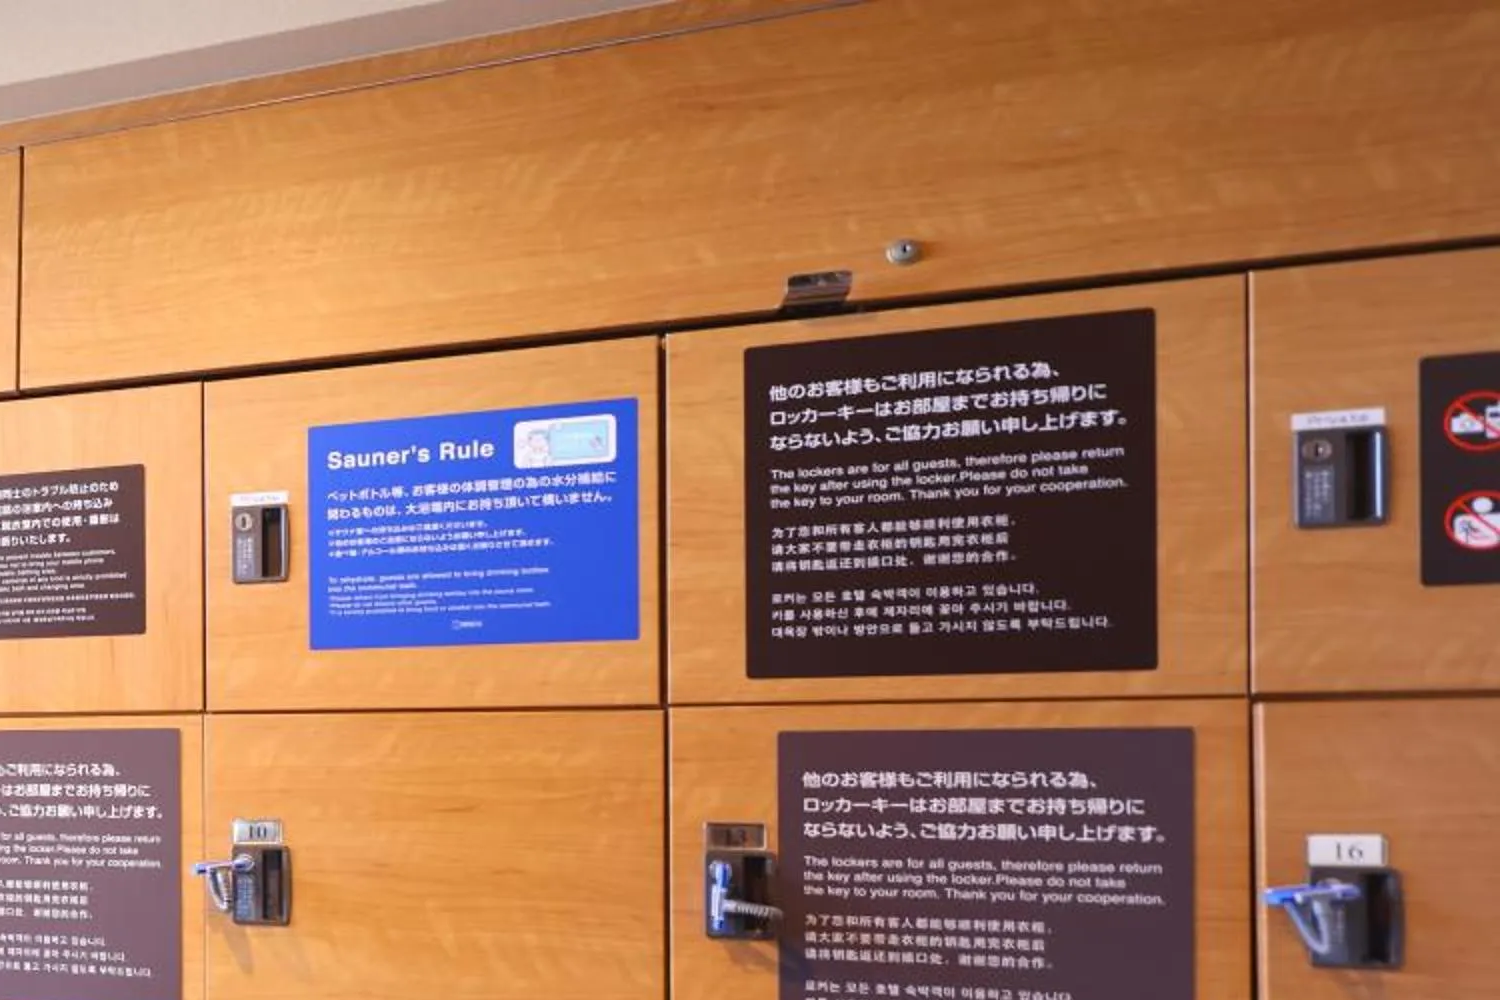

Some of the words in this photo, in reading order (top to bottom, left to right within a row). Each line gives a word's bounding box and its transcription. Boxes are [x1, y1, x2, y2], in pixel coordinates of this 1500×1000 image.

[768, 361, 1059, 402] 他のお客様もご利用になられる為、
[769, 383, 1106, 426] ロッカーキーはお部屋までお持ち帰りに
[769, 408, 1126, 451] ならないよう、ご協力お願い申し上げます。
[327, 444, 430, 470] Sauner's
[439, 439, 495, 460] Rule
[769, 468, 794, 479] The
[797, 466, 844, 478] lockers
[847, 464, 869, 475] are
[871, 462, 890, 473] for
[893, 459, 909, 472] all
[964, 452, 1027, 466] therefore
[1030, 450, 1078, 464] please
[1081, 447, 1125, 459] return
[769, 483, 790, 495] the
[793, 482, 816, 494] key
[819, 479, 849, 491] after
[852, 478, 887, 490] using
[891, 475, 912, 486] the
[1010, 467, 1028, 479] do
[1032, 465, 1053, 476] not
[1058, 463, 1088, 475] take
[769, 498, 791, 509] the
[793, 497, 817, 509] key
[819, 495, 833, 506] to
[835, 494, 864, 507] your
[867, 491, 904, 503] room.
[908, 487, 950, 500] Thank
[954, 487, 979, 500] you
[983, 483, 1001, 496] for
[1005, 483, 1036, 497] your
[1039, 477, 1127, 493] cooperation.
[801, 770, 1096, 788] 他のお客様もご利用になられる為、
[803, 797, 1145, 815] ロッカーキーはお部屋までお持ち帰りに
[249, 825, 267, 838] 10
[803, 821, 1165, 842] ならないよう、ご協力お願い申し上げます。
[1336, 841, 1363, 862] 16
[803, 854, 828, 867] The
[831, 855, 878, 868] lockers
[881, 859, 903, 868] are
[906, 856, 924, 869] for
[928, 857, 944, 869] all
[1000, 859, 1064, 872] therefore
[1067, 860, 1115, 874] please
[1118, 862, 1163, 874] return
[803, 869, 823, 881] the
[827, 870, 850, 884] key
[853, 871, 883, 882] after
[887, 873, 922, 886] using
[926, 872, 947, 885] the
[1046, 875, 1064, 887] do
[1068, 877, 1090, 887] not
[1095, 877, 1126, 888] take
[803, 884, 825, 896] the
[827, 885, 850, 899] key
[853, 886, 867, 897] to
[869, 887, 899, 899] your
[901, 888, 939, 899] room.
[943, 887, 986, 900] Thank
[989, 891, 1015, 903] you
[1019, 889, 1038, 902] for
[1041, 892, 1073, 904] your
[1075, 893, 1165, 906] cooperation.
